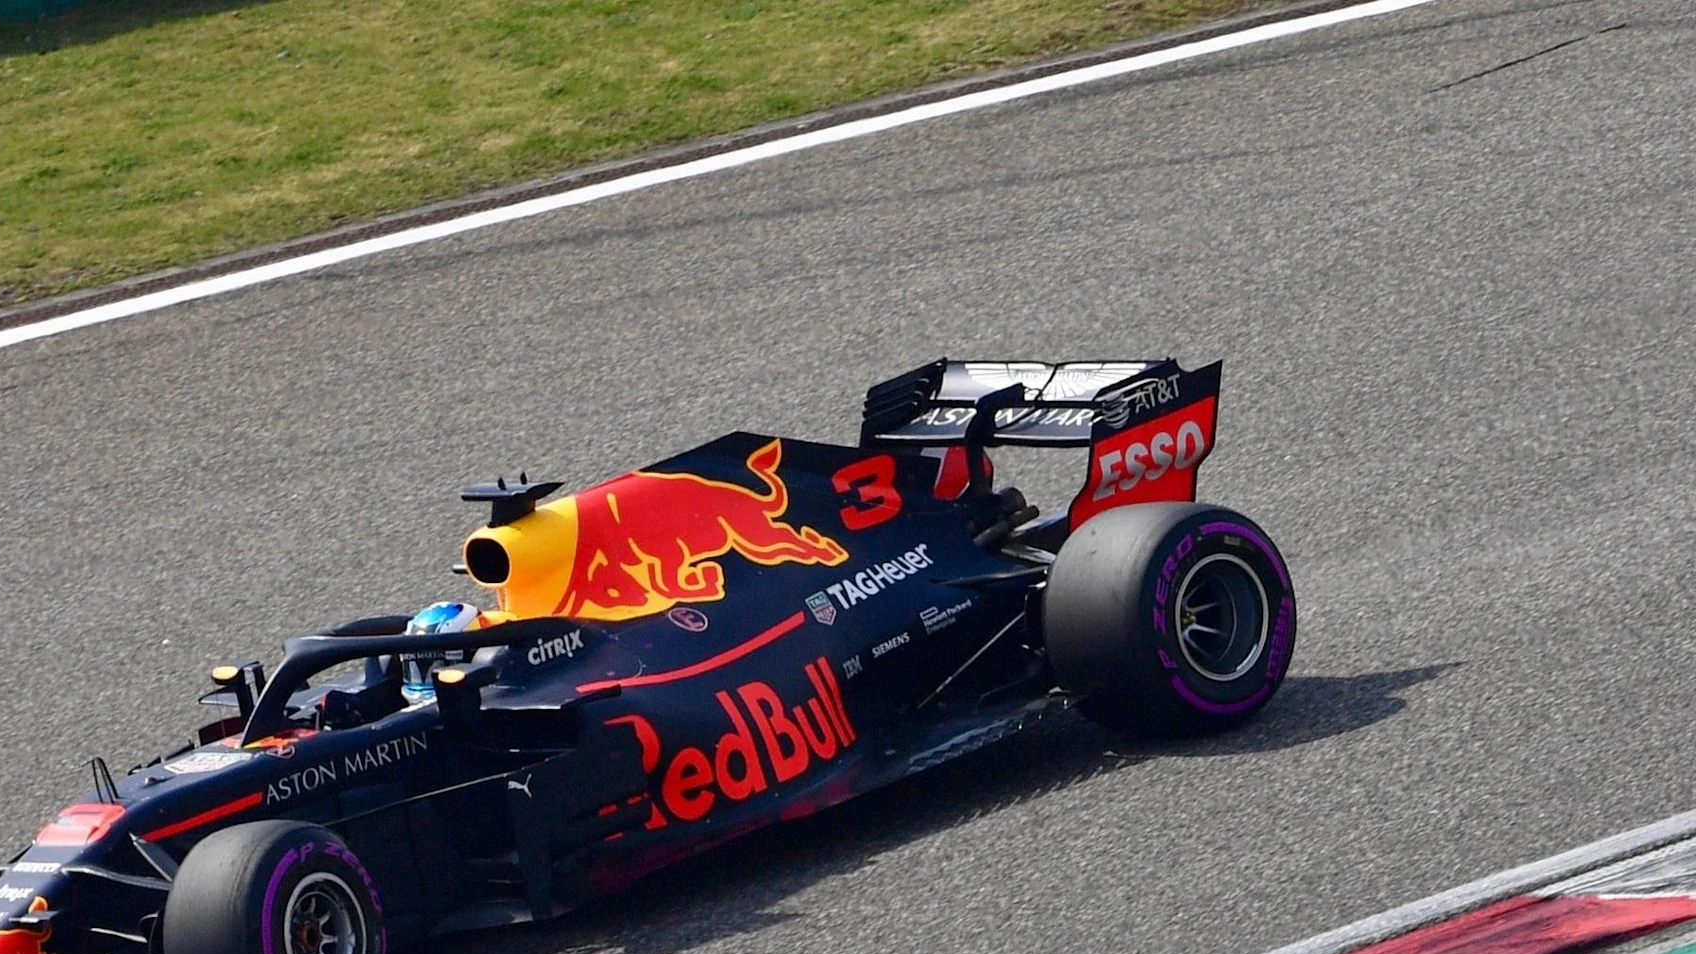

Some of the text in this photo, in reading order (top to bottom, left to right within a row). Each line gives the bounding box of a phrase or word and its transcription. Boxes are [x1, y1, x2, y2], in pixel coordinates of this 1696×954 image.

[1135, 374, 1182, 414] AT&T
[830, 454, 904, 532] 3
[1093, 420, 1204, 501] ESSO
[872, 632, 910, 658] SIEMENS
[266, 762, 337, 804] ASTON
[345, 731, 428, 776] MARTIN
